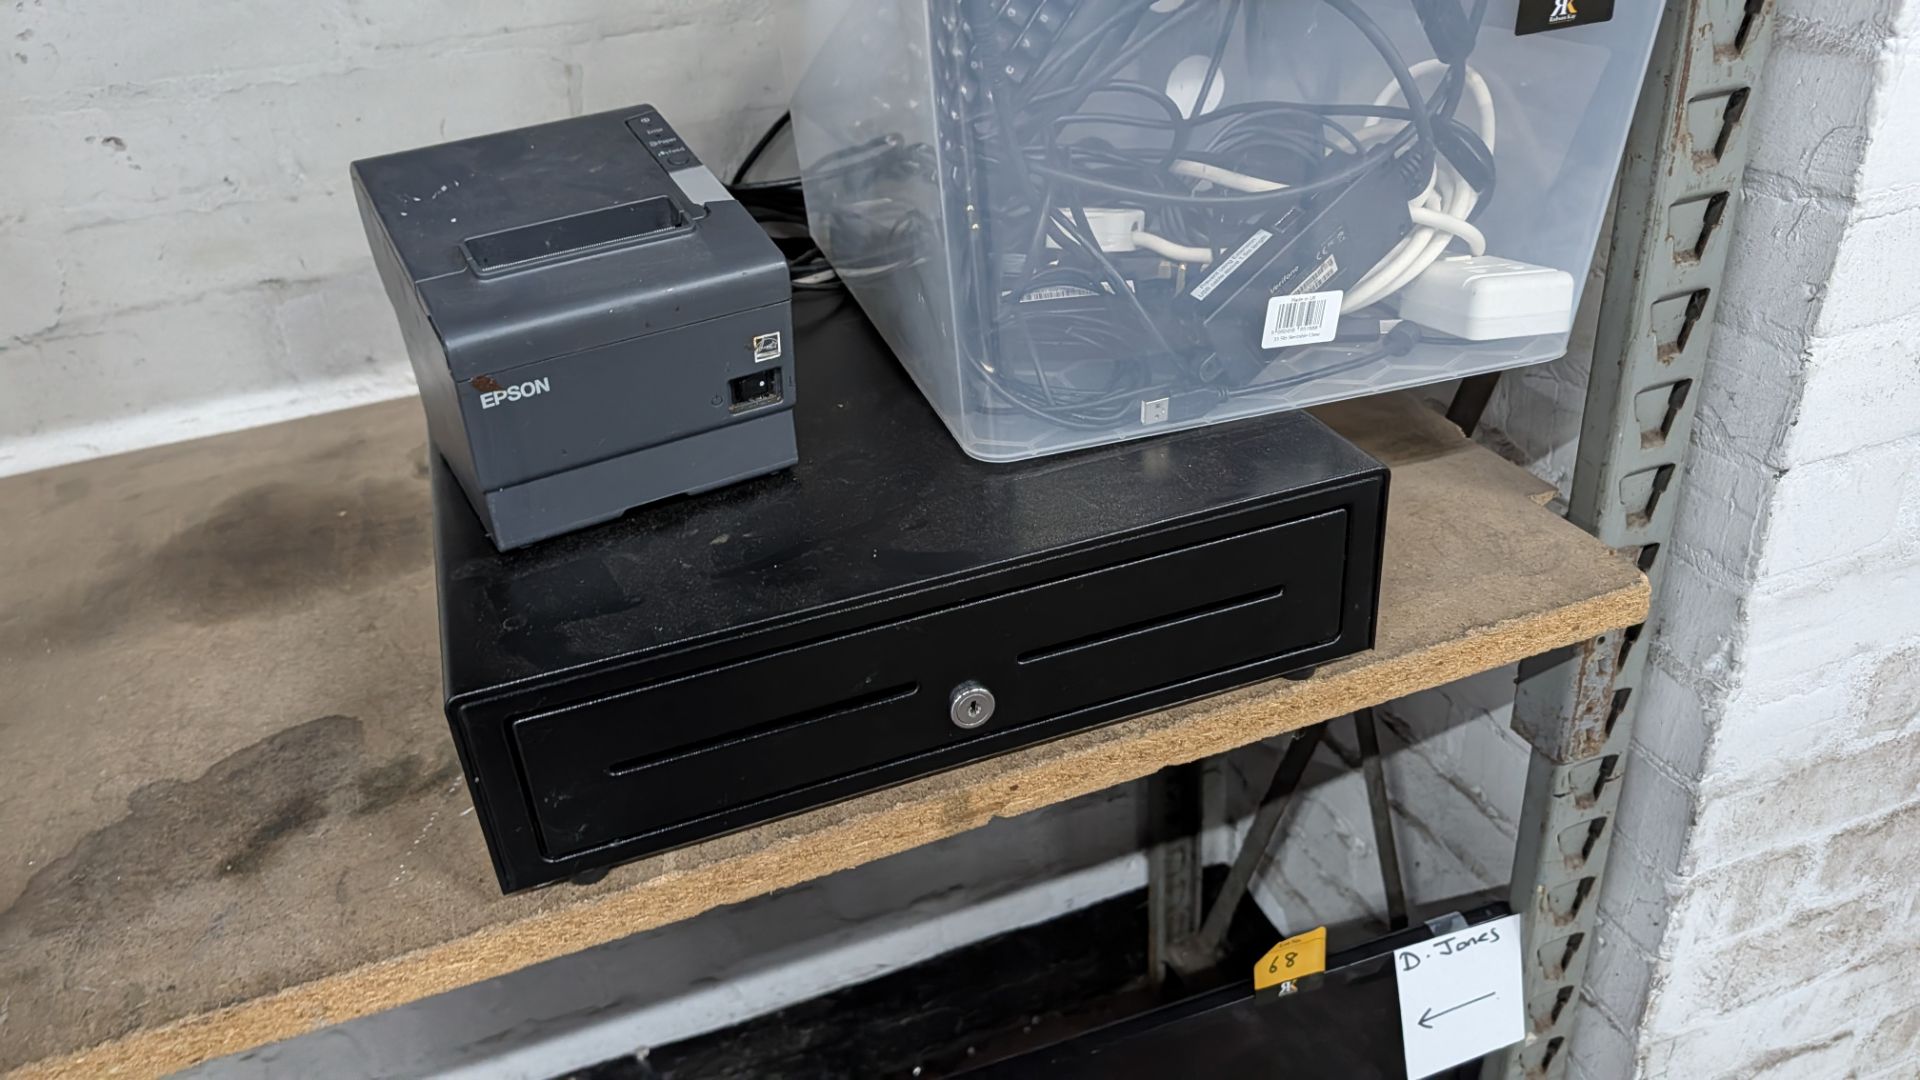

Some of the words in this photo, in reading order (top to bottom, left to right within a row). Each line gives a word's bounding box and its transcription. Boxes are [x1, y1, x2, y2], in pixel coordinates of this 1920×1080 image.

[479, 376, 551, 410] EPSON
[1432, 927, 1501, 956] Jones
[1269, 951, 1299, 974] 68
